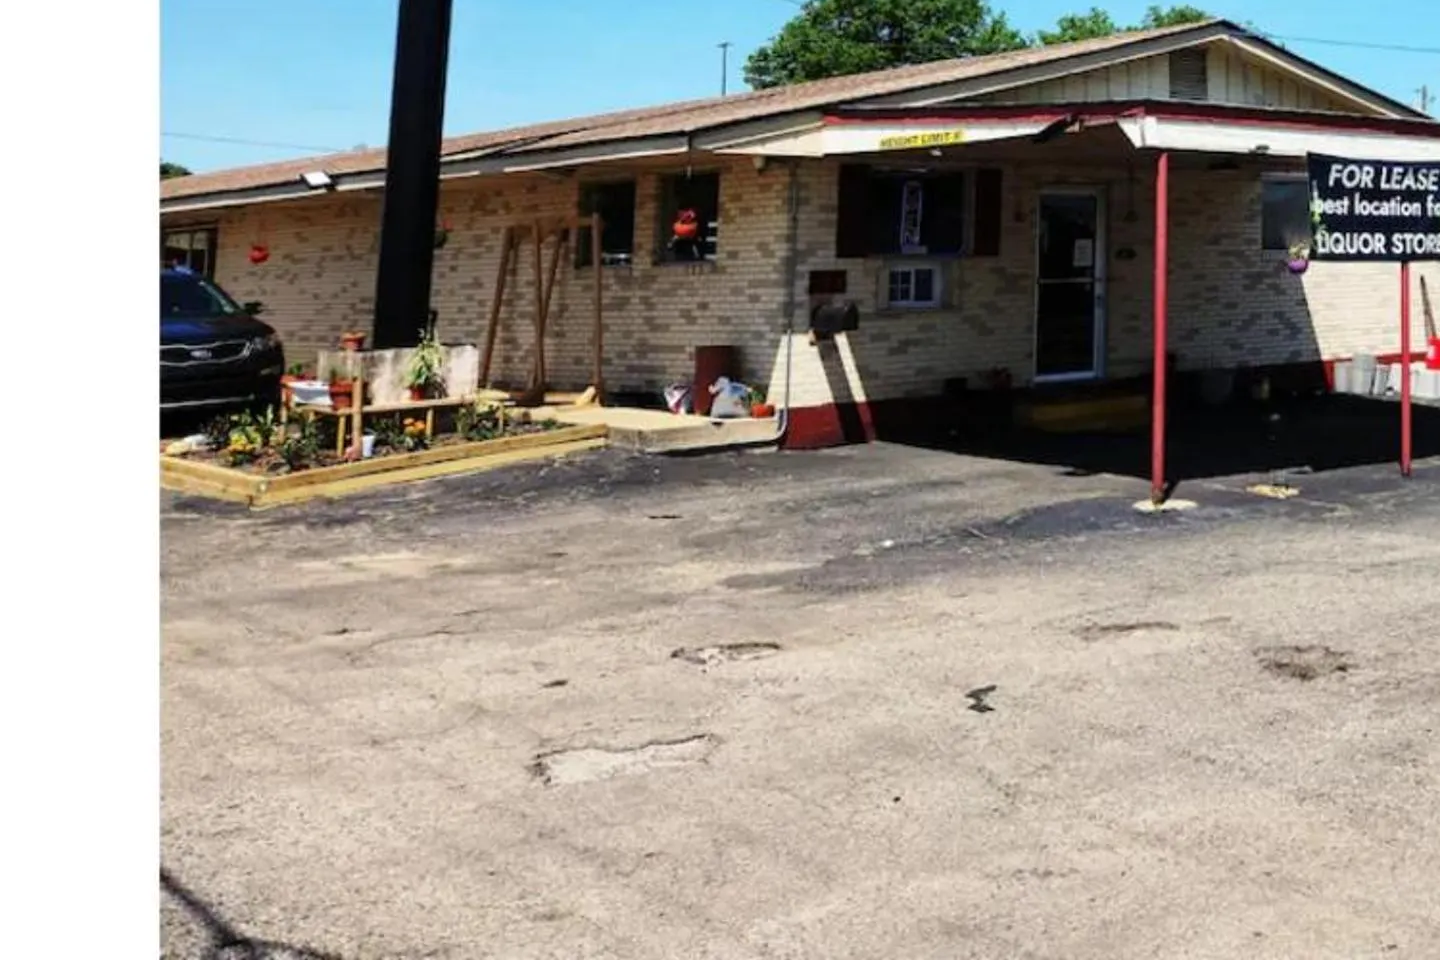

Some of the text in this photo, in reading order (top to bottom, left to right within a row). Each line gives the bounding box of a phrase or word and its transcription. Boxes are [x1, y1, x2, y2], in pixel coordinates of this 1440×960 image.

[1328, 163, 1440, 191] FOR LEASE
[1354, 192, 1422, 217] location
[1317, 231, 1386, 255] LIQUOR
